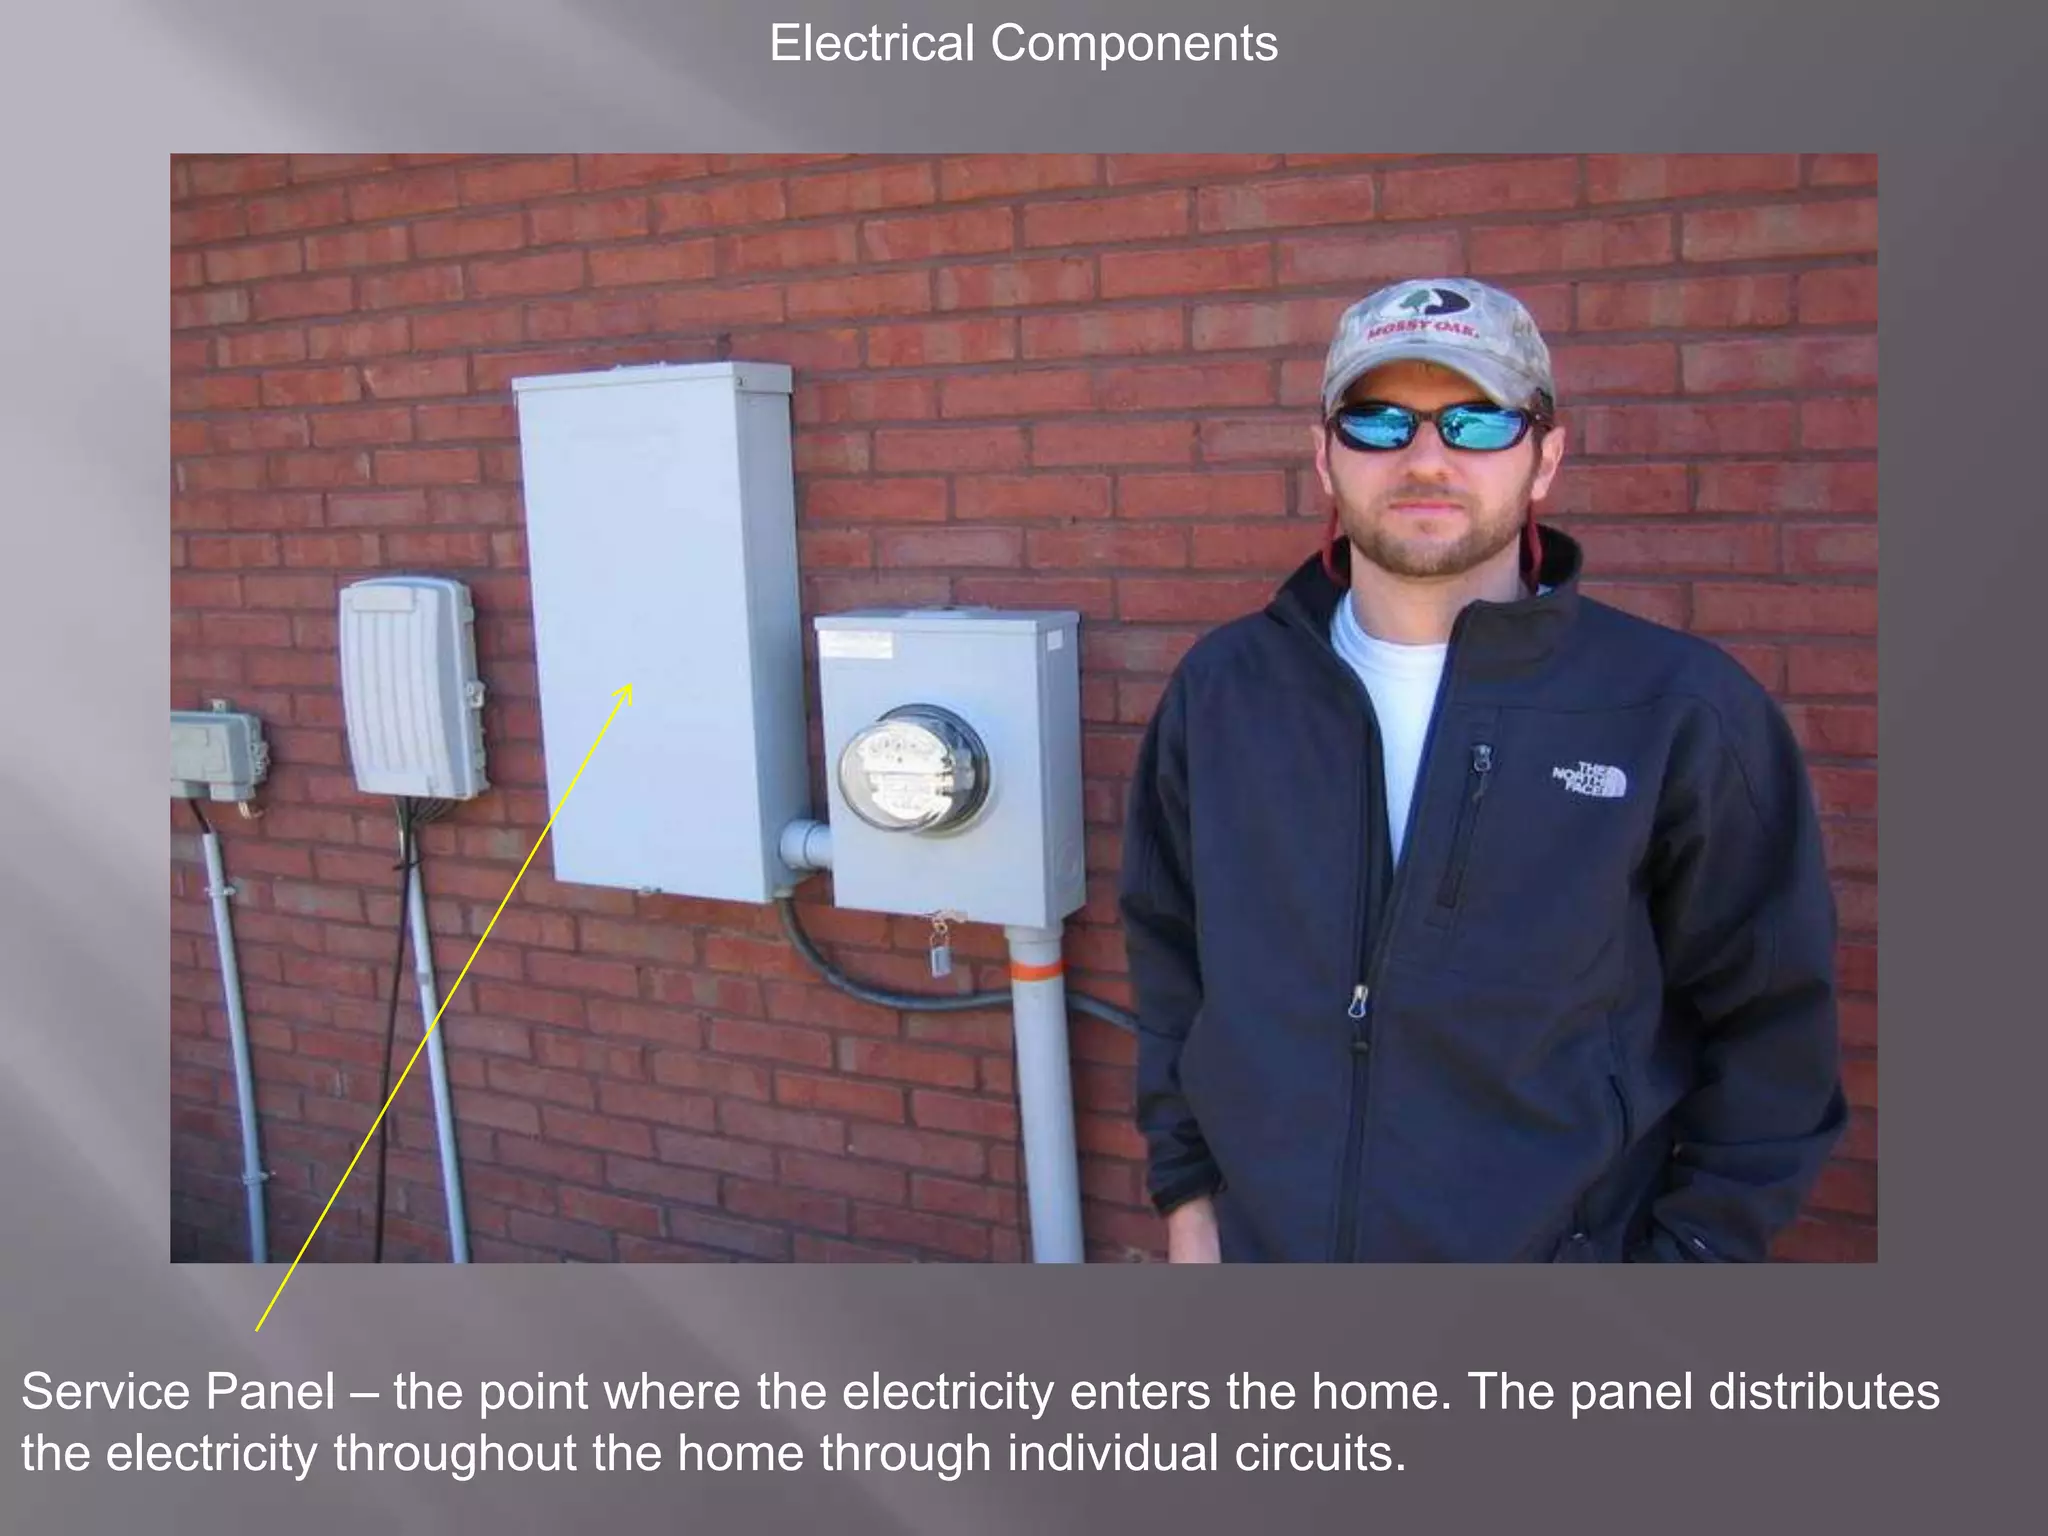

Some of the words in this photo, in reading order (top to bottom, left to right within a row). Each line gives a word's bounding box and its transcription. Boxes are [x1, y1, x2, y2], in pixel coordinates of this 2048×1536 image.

[1366, 319, 1433, 341] MOSSY
[1552, 766, 1606, 787] NORTH
[1579, 760, 1606, 777] THE
[1564, 779, 1603, 797] FACE
